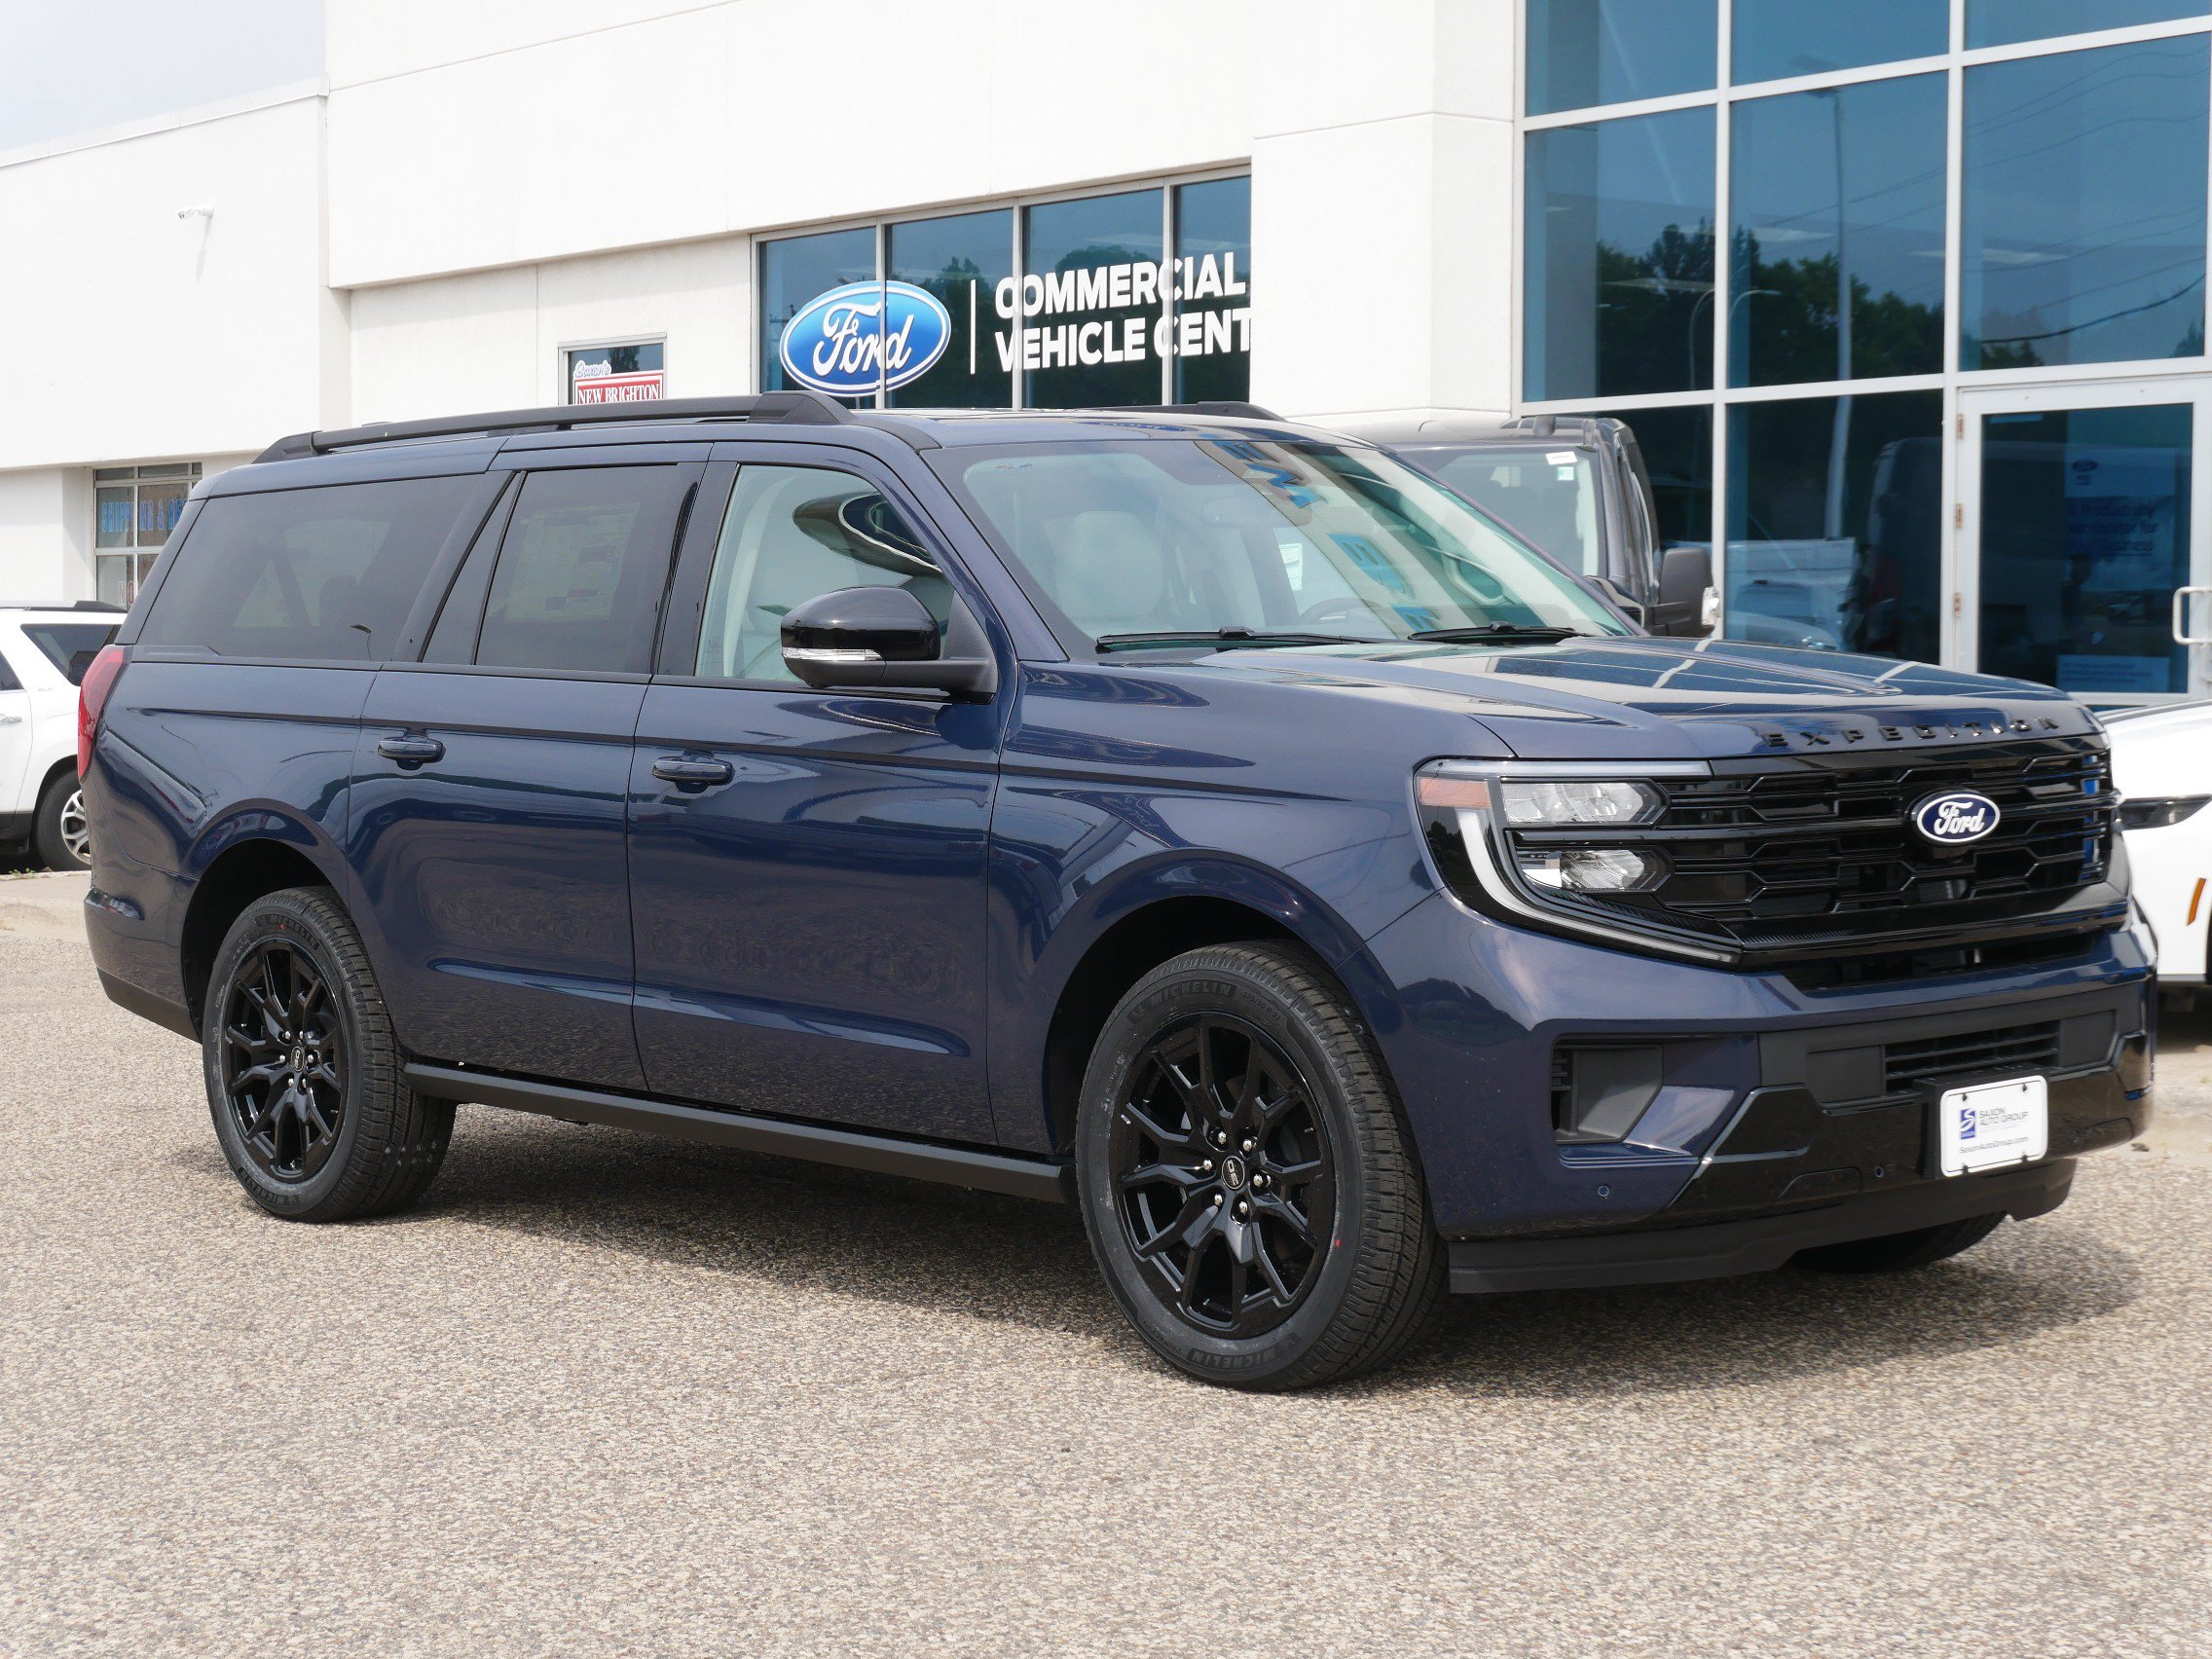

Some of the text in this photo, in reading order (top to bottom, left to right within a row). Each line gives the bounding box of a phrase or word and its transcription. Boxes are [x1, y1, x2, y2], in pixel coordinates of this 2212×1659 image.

[995, 251, 1247, 319] COMMERCIAL
[812, 296, 913, 376] Ford
[994, 308, 1251, 372] VEHICLE CENT
[577, 384, 660, 405] NEW BRIGHTON
[102, 498, 189, 533] SHIPPING & RE
[118, 580, 138, 606] NO
[1934, 801, 1986, 835] Ford
[1151, 979, 1232, 1005] MICHELIN
[1192, 1346, 1276, 1369] MICHELIN
